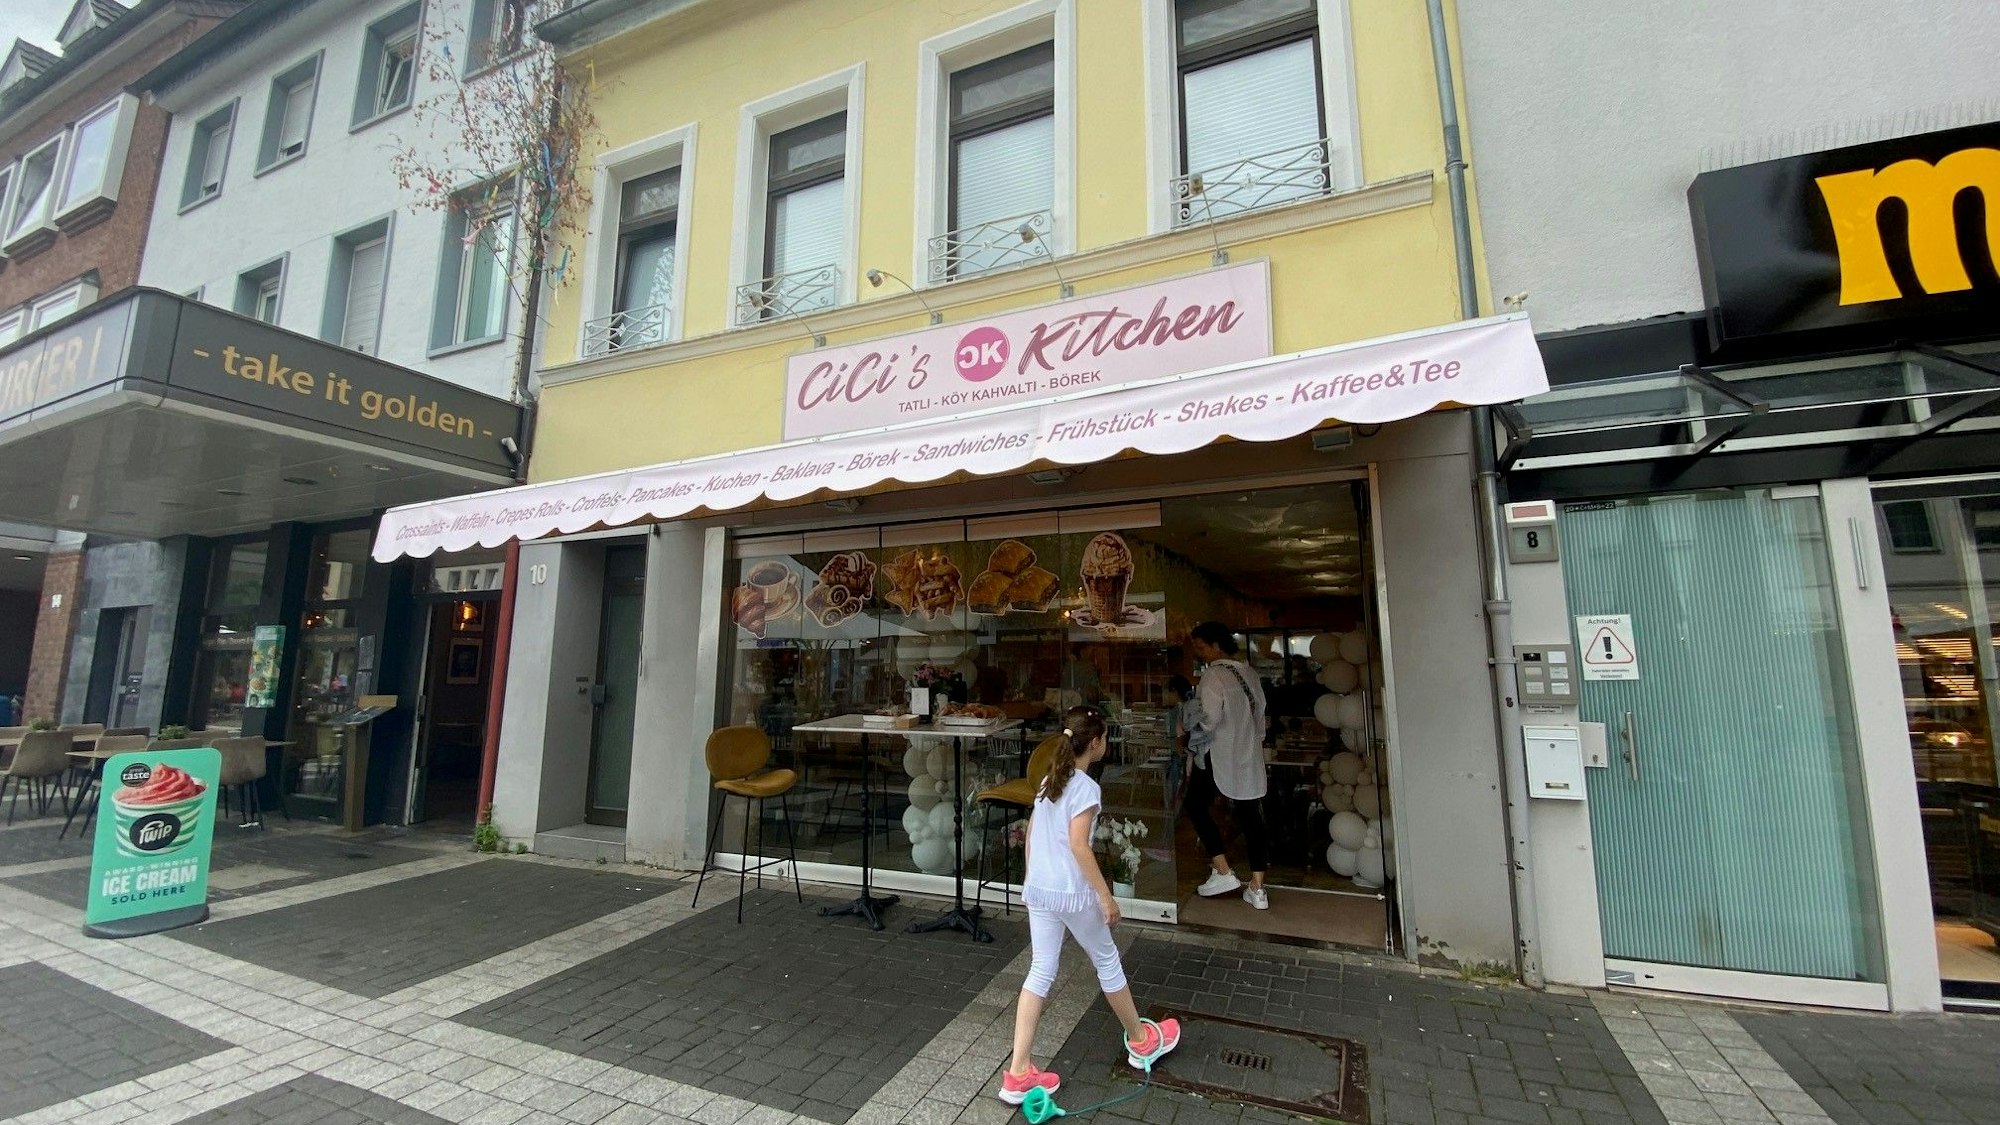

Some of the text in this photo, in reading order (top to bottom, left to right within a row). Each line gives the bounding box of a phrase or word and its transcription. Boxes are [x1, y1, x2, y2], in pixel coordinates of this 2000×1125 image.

[1017, 296, 1245, 375] Kitchen
[223, 345, 315, 395] take
[325, 372, 352, 405] it
[360, 389, 475, 438] golden
[799, 345, 930, 411] CiCi's
[898, 398, 931, 413] TATLI
[941, 391, 970, 406] KÖY
[972, 381, 1037, 402] KAHVALTI
[1050, 370, 1101, 389] BÖREK
[450, 511, 490, 532] Waffeln
[534, 499, 566, 519] Rolls
[571, 491, 620, 513] Croffels
[626, 481, 695, 504] Pancakes
[702, 472, 762, 493] Kuchen
[770, 461, 836, 482] Baklava
[846, 448, 901, 471] Börek
[913, 432, 1029, 463] Sandwiches
[1048, 408, 1159, 443] Frühstück
[1177, 391, 1269, 422] Shakes
[1291, 358, 1461, 405] Kaffee&Tee
[1527, 531, 1539, 548] 8
[530, 564, 547, 585] 10
[122, 772, 150, 780] taste
[102, 865, 198, 897] ICE CREAM
[111, 885, 186, 905] SOLD HERE
